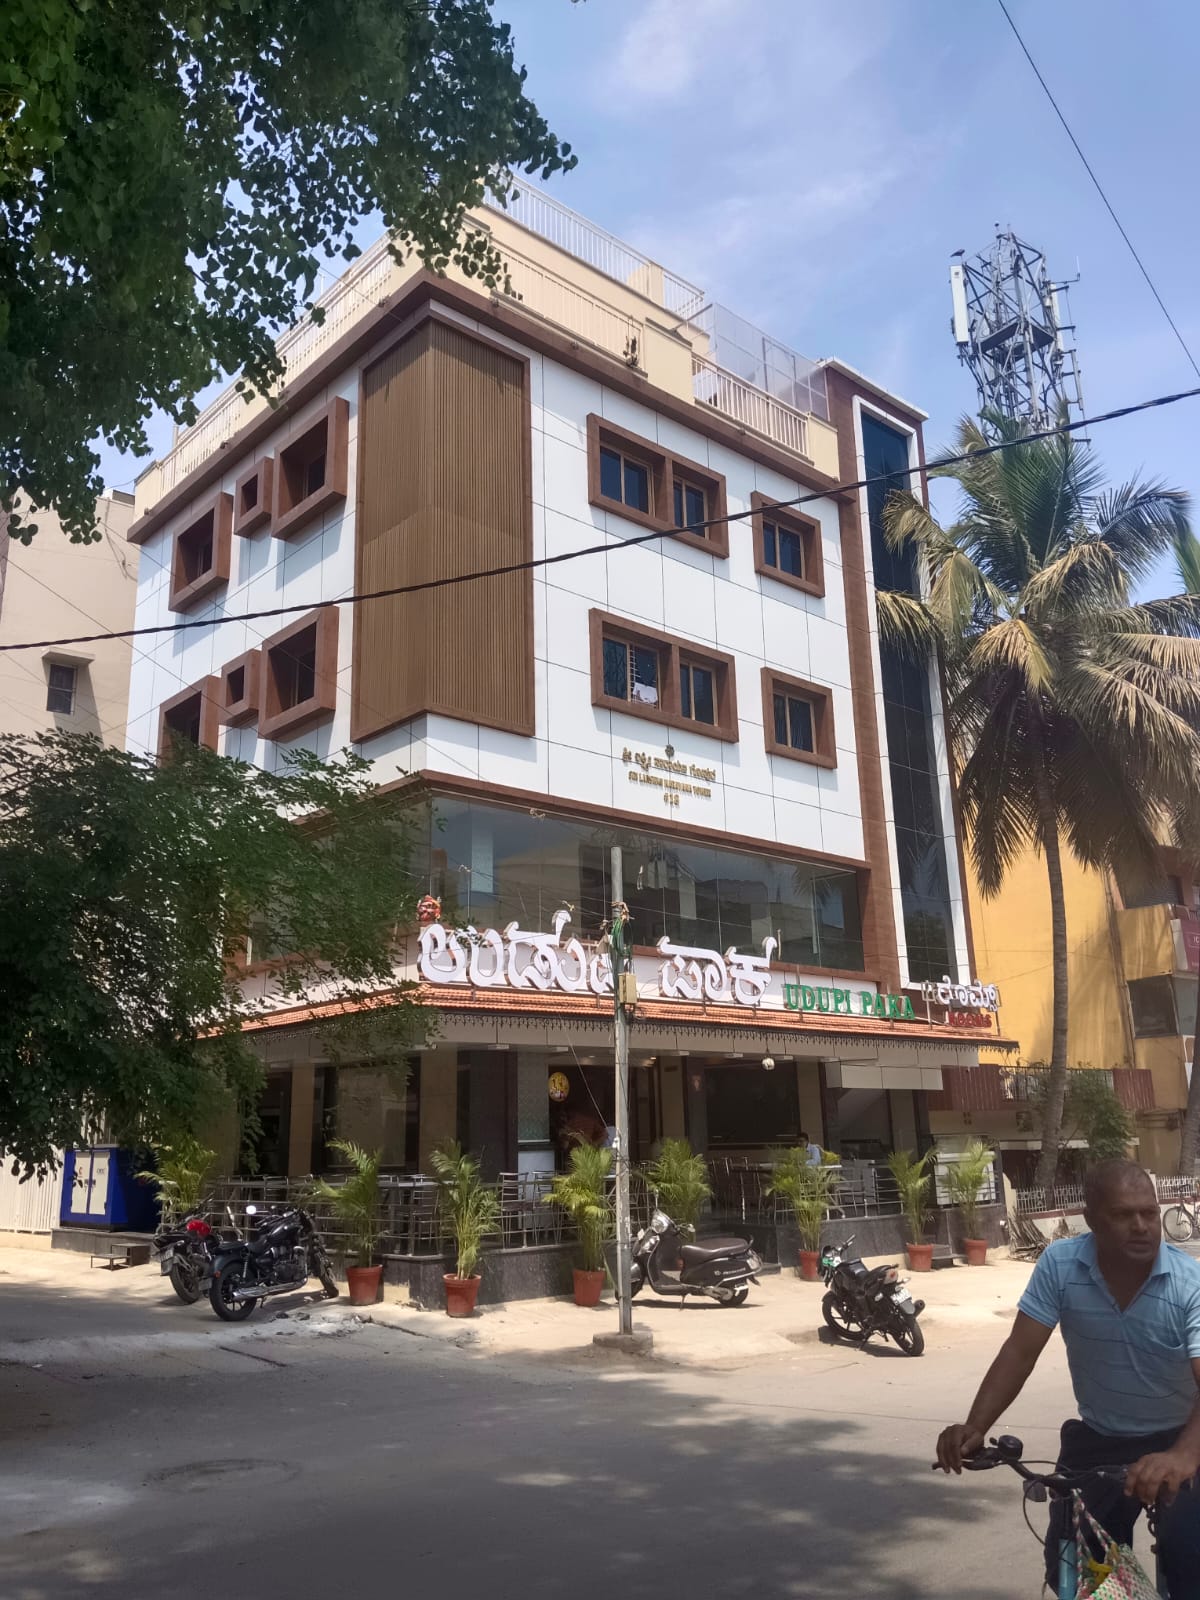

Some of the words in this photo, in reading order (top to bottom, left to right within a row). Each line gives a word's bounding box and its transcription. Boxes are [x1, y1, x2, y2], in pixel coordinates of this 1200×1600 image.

[656, 935, 777, 1005] ಪಾಕ
[783, 983, 853, 1015] UDUPI
[860, 990, 915, 1021] PAKA
